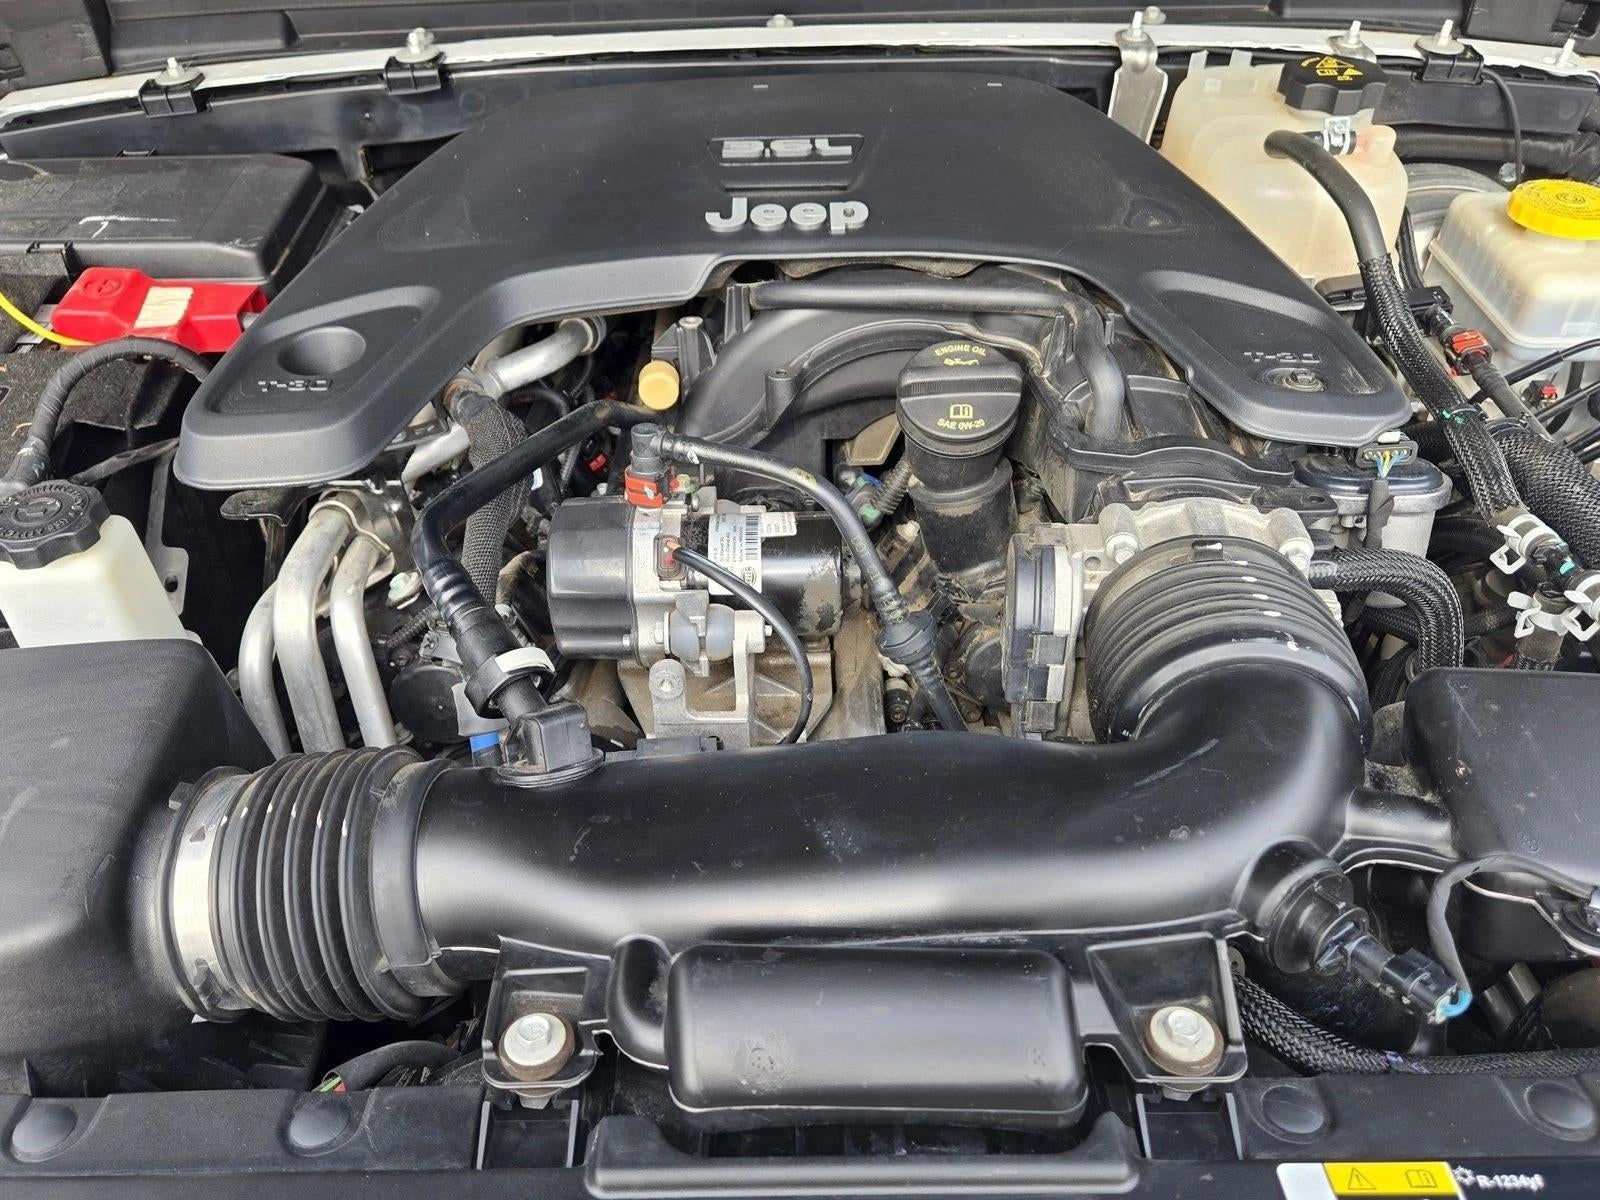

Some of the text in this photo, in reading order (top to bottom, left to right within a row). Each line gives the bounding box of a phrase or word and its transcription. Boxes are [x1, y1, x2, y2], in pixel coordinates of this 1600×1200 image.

[705, 197, 869, 235] Jeep
[934, 344, 987, 356] ENGINE OIL
[937, 418, 985, 430] SAE 0W-20
